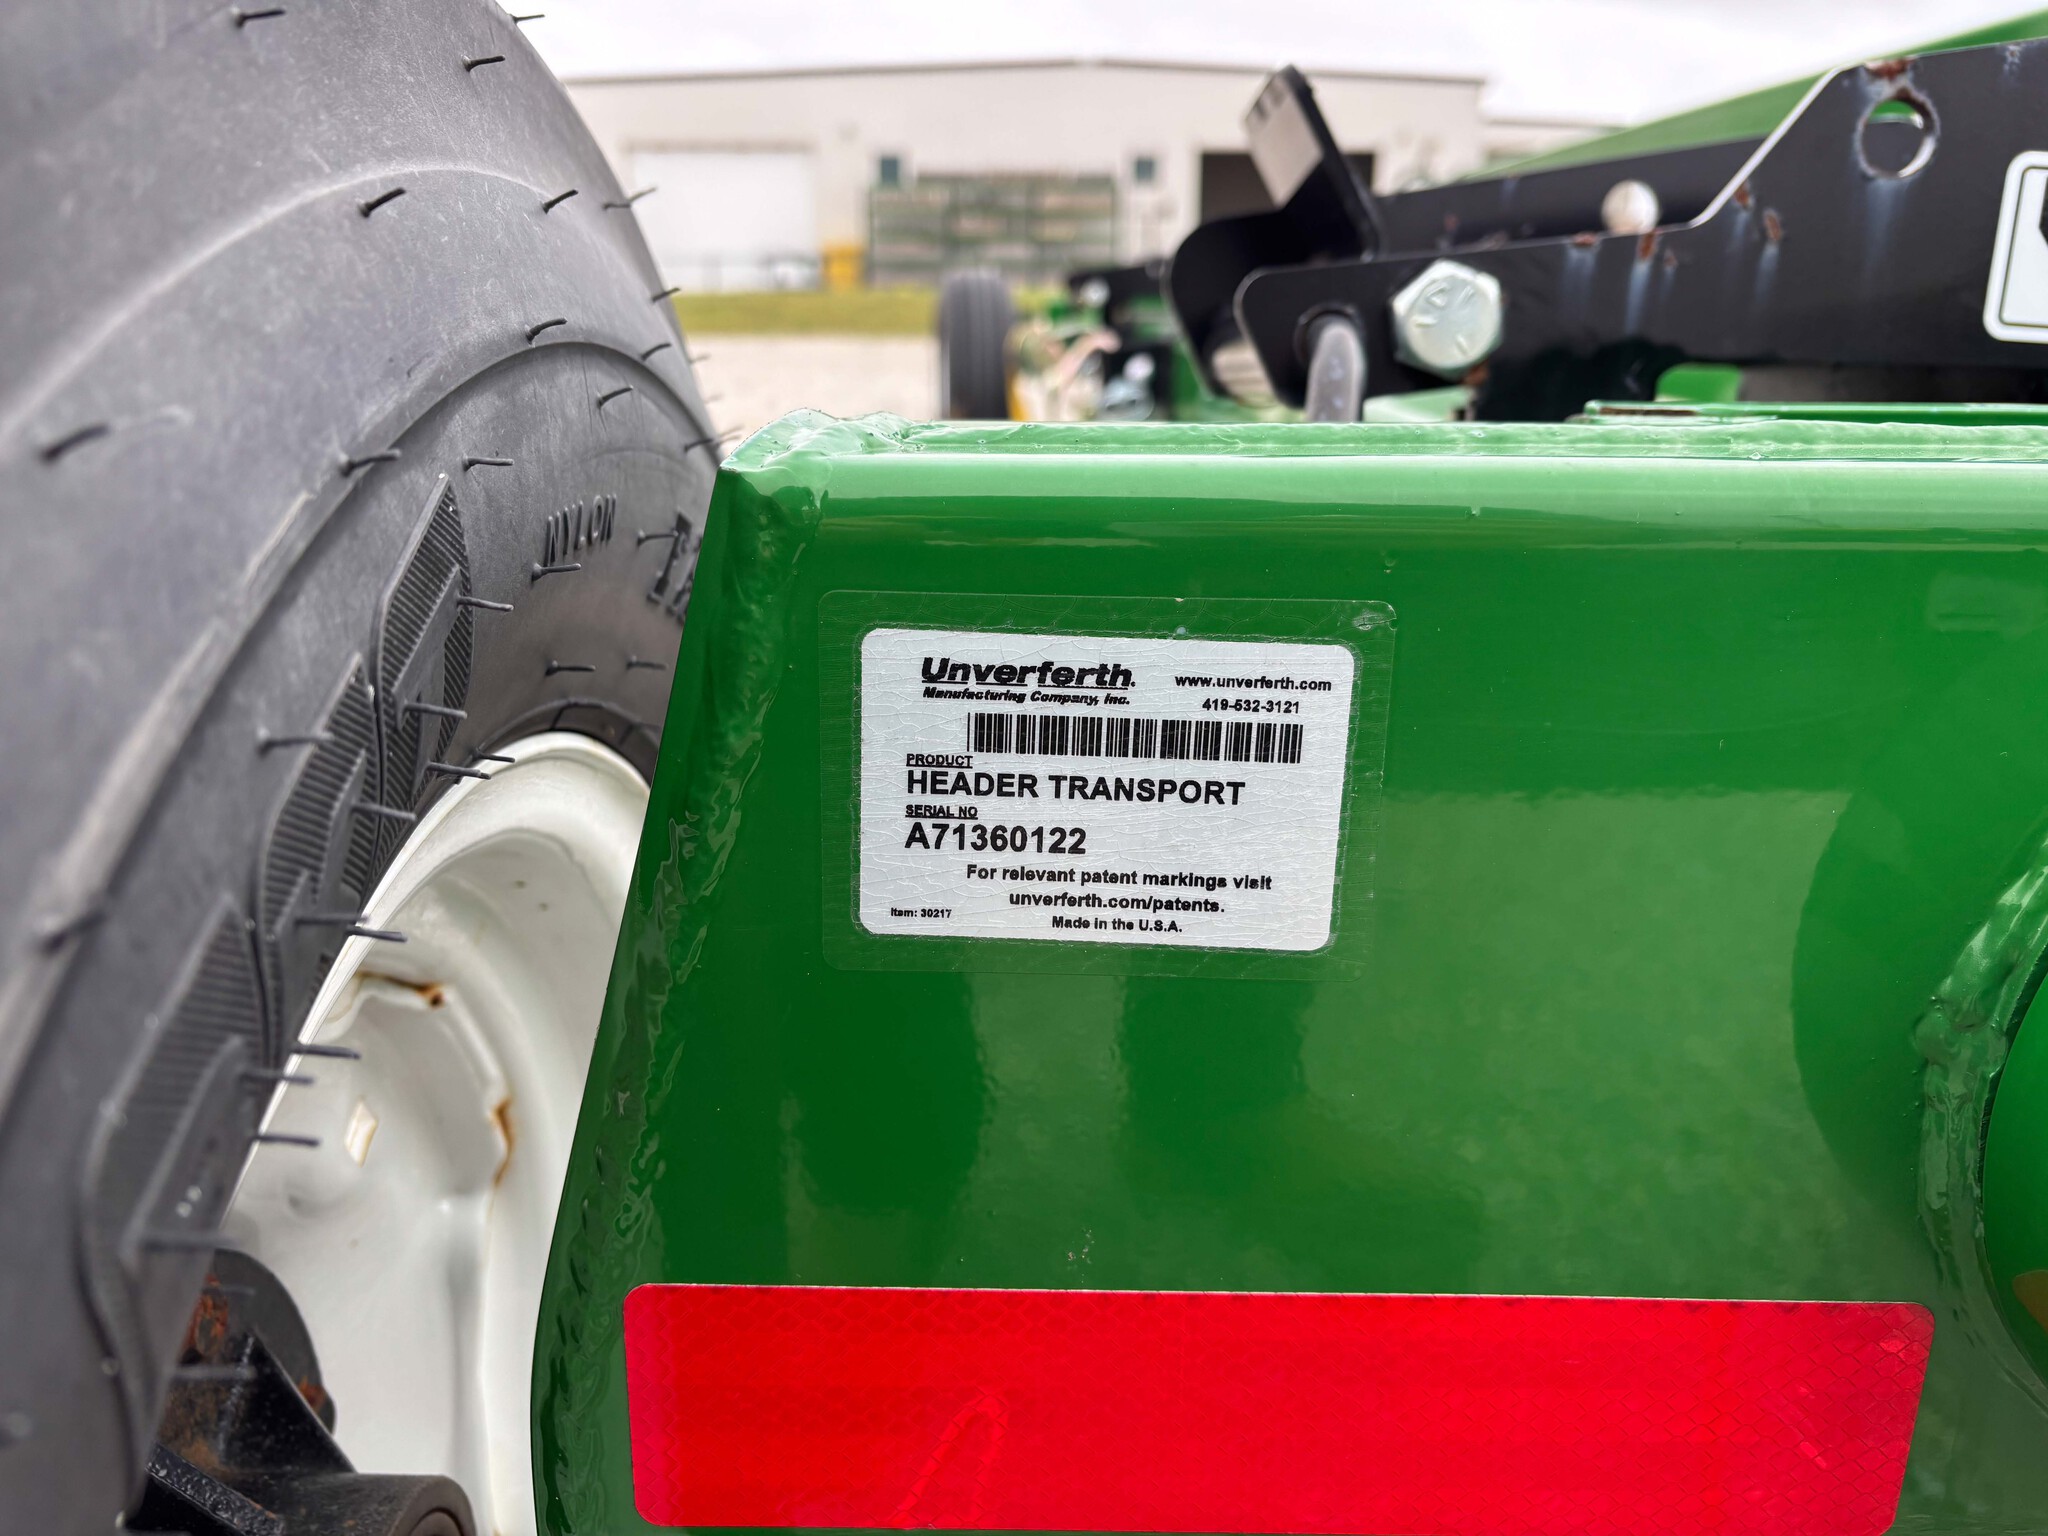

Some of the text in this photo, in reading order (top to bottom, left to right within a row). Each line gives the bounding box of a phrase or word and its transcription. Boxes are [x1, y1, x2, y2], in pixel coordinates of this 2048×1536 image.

[1175, 676, 1332, 691] www.unverferth.com
[923, 687, 1130, 706] Manufacturing Company, Inc.
[1202, 698, 1299, 714] 419-532-3121
[906, 753, 973, 768] PRODUCT
[907, 770, 1246, 805] HEADER TRANSPORT
[905, 804, 978, 820] SERIAL NO
[905, 822, 1086, 854] A71360122
[966, 864, 1272, 891] For relevant patent markings visit
[1010, 892, 1225, 913] unverferth.com/patents.
[890, 907, 952, 918] Item: 30217
[1052, 916, 1183, 932] Made in the U.S.A.
